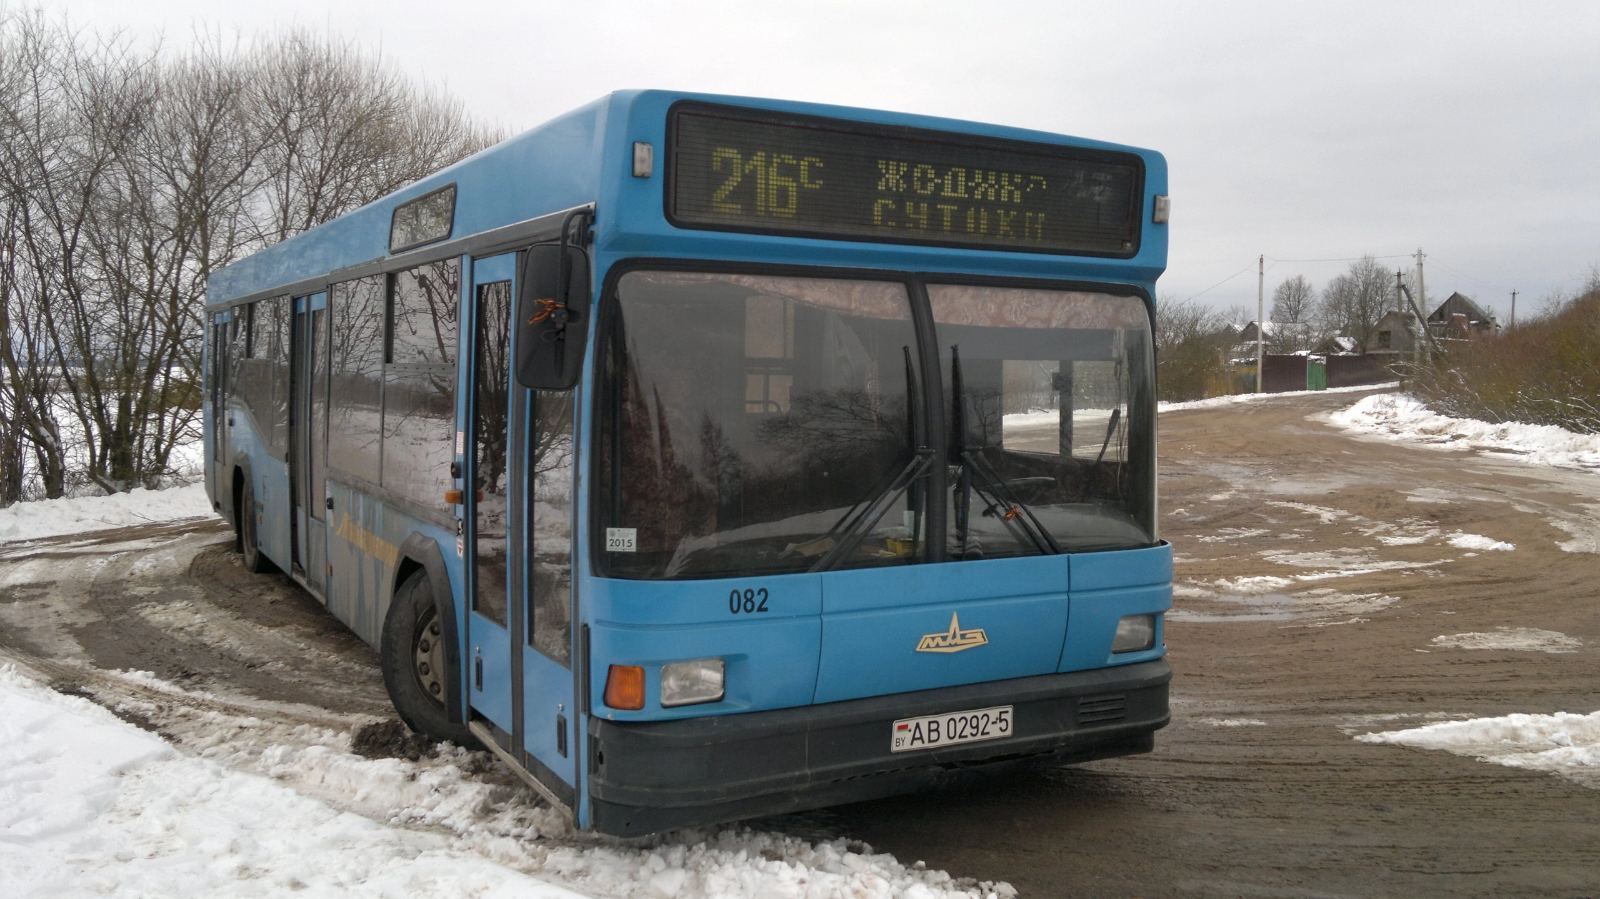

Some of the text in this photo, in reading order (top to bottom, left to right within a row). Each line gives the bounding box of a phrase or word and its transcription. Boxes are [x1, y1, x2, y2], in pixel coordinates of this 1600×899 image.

[609, 538, 633, 548] 2015
[729, 587, 769, 614] 082
[946, 710, 1010, 740] 0292-5
[895, 736, 906, 748] BY
